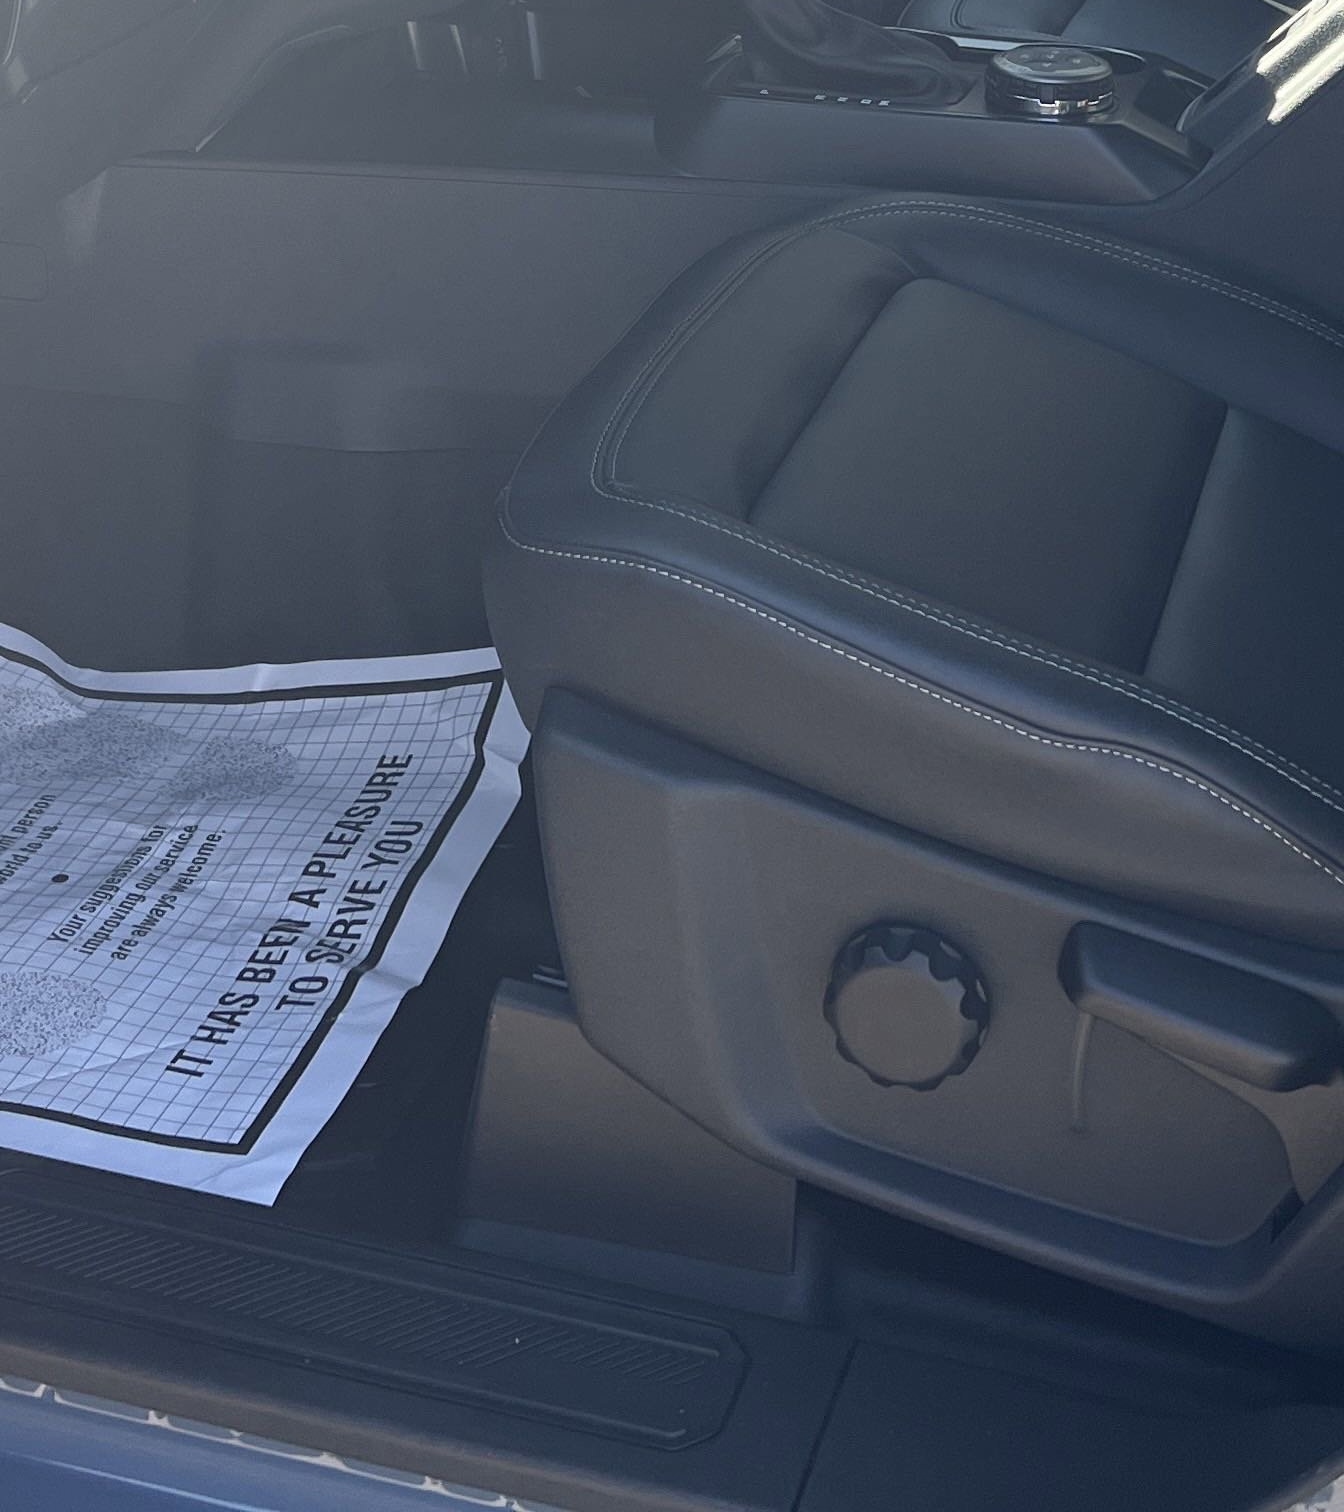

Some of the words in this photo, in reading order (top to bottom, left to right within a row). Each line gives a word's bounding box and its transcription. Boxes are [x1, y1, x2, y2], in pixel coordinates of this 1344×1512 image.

[9, 794, 57, 838] person
[27, 838, 45, 856] to
[40, 821, 64, 842] us.
[301, 753, 413, 879] PLEASURE
[46, 913, 87, 945] Your
[80, 844, 153, 915] suggestions
[141, 824, 168, 844] for
[73, 891, 147, 956] improving
[135, 870, 163, 893] our
[154, 823, 199, 874] service
[111, 934, 140, 961] are
[131, 891, 178, 938] always
[171, 829, 227, 893] welcome.
[274, 975, 330, 1011] TO
[305, 879, 388, 964] SERVE
[361, 820, 424, 870] YOU
[288, 887, 327, 909] A
[236, 917, 312, 984] BEEN
[190, 992, 260, 1046] HAS
[164, 1048, 214, 1078] IT
